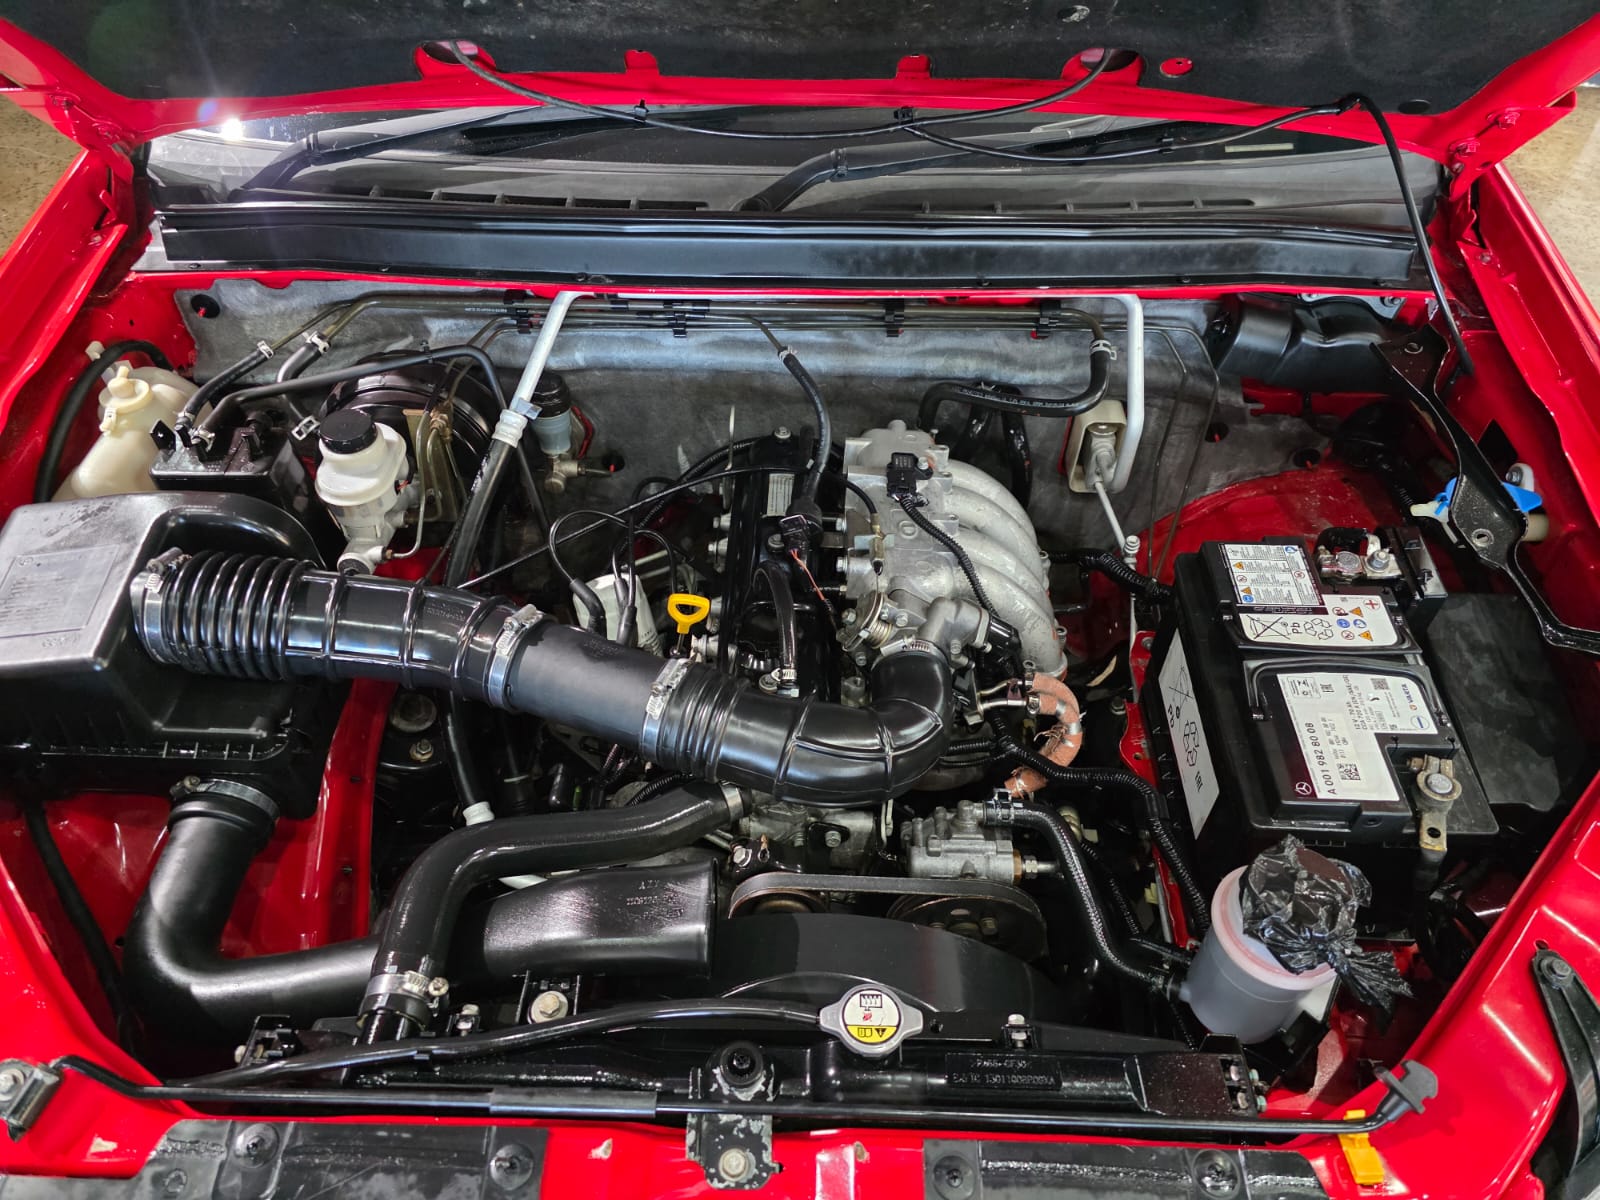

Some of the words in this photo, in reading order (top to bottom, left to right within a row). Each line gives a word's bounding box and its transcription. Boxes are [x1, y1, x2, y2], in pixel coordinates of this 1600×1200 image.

[1290, 622, 1302, 634] Pb
[1167, 703, 1175, 729] Pb
[1304, 722, 1316, 734] 08
[1309, 735, 1321, 747] 80
[1314, 749, 1327, 766] 982
[1321, 769, 1333, 786] 001
